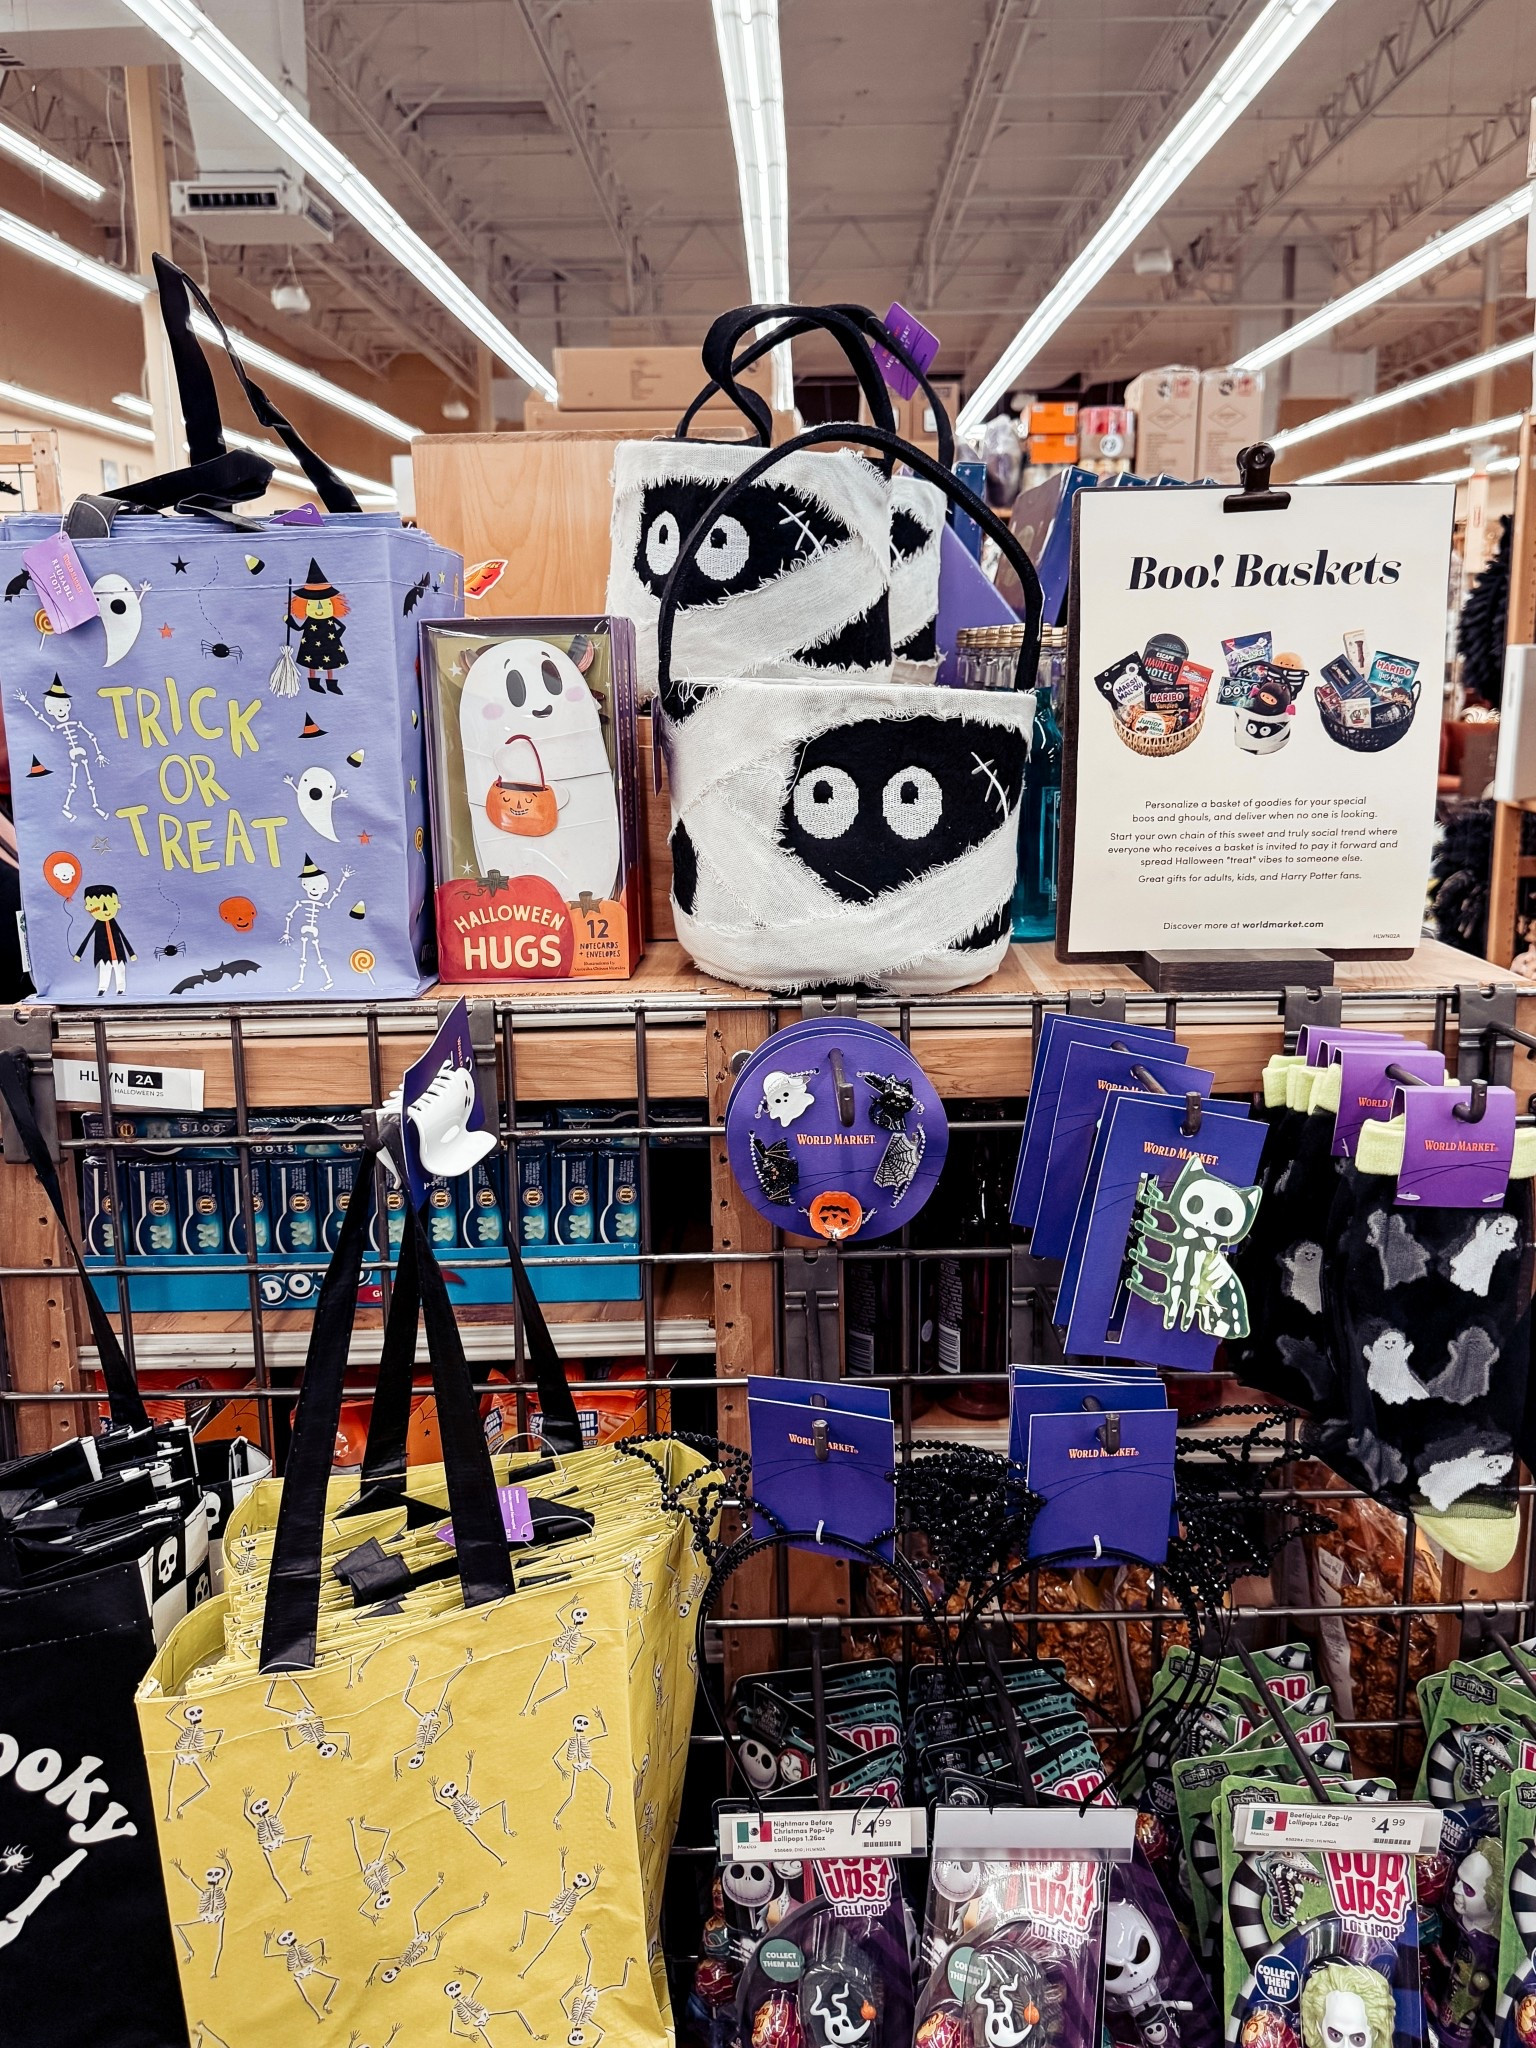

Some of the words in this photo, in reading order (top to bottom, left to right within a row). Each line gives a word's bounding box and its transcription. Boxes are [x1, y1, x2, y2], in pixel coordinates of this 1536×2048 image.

[1125, 554, 1224, 590] Boo!
[1230, 549, 1402, 588] Baskets
[50, 572, 62, 596] TOTE
[52, 558, 74, 602] REUSABLE
[1144, 657, 1180, 672] HAUNTED
[1376, 660, 1412, 677] HARIBO
[1150, 692, 1184, 703] HARIBO
[97, 677, 262, 758] TRICK
[1138, 718, 1162, 728] Junior
[159, 754, 231, 808] OR
[1146, 800, 1198, 810] Personalize
[1210, 799, 1240, 808] basket
[1254, 798, 1292, 809] goodies
[1333, 797, 1366, 807] special
[1178, 813, 1211, 823] ghouls,
[1235, 812, 1267, 820] deliver
[1341, 810, 1378, 820] looking.
[115, 804, 288, 874] TREAT
[1110, 832, 1132, 841] Start
[1134, 833, 1155, 842] your
[1180, 831, 1205, 839] chain
[1267, 830, 1285, 838] and
[1288, 829, 1309, 838] truly
[1311, 828, 1338, 836] social
[1341, 828, 1366, 836] trend
[1368, 828, 1398, 836] where
[1108, 847, 1150, 855] everyone
[1174, 844, 1212, 852] receives
[1266, 842, 1297, 850] invited
[1311, 842, 1329, 851] pay
[1340, 841, 1377, 849] forward
[1380, 840, 1398, 848] and
[1140, 858, 1172, 867] spread
[1176, 857, 1224, 865] Halloween
[1138, 875, 1164, 883] Great
[1167, 874, 1186, 884] gifts
[1189, 874, 1201, 882] for
[1204, 874, 1234, 882] adults,
[1237, 873, 1257, 882] kids,
[1281, 872, 1307, 882] Harry
[1309, 872, 1337, 880] Potter
[1340, 871, 1362, 879] fans.
[454, 904, 566, 934] HALLOWEEN
[1163, 922, 1202, 930] Discover
[1242, 920, 1324, 929] worldmarket.com
[586, 919, 609, 938] 12
[463, 934, 562, 970] HUGS
[586, 950, 620, 958] ENVELOPES
[79, 1070, 124, 1084] HLN
[135, 1074, 154, 1086] 2A
[1358, 1097, 1388, 1108] WORLD
[797, 1134, 832, 1145] WORLD
[834, 1134, 876, 1144] MARKET
[1424, 1140, 1456, 1150] WORLD
[1458, 1141, 1496, 1152] MARKET
[255, 1144, 295, 1153] DOTS
[1143, 1141, 1176, 1157] WORLD
[827, 1442, 855, 1453] ARKET
[1069, 1449, 1099, 1458] WORLD
[1288, 1820, 1318, 1828] Lollipops
[809, 1827, 835, 1835] Pop-Up
[774, 1835, 804, 1843] Lollipops
[825, 1860, 889, 1899] ups!
[1336, 1876, 1406, 1919] ups!
[836, 1904, 885, 1916] LOLLIPOP
[1343, 1918, 1398, 1940] LOLLIPOP
[763, 1960, 785, 1968] THEM
[1258, 1964, 1296, 1981] COLLECT
[1263, 1974, 1290, 1990] THEM
[1267, 1986, 1287, 1998] ALL!
